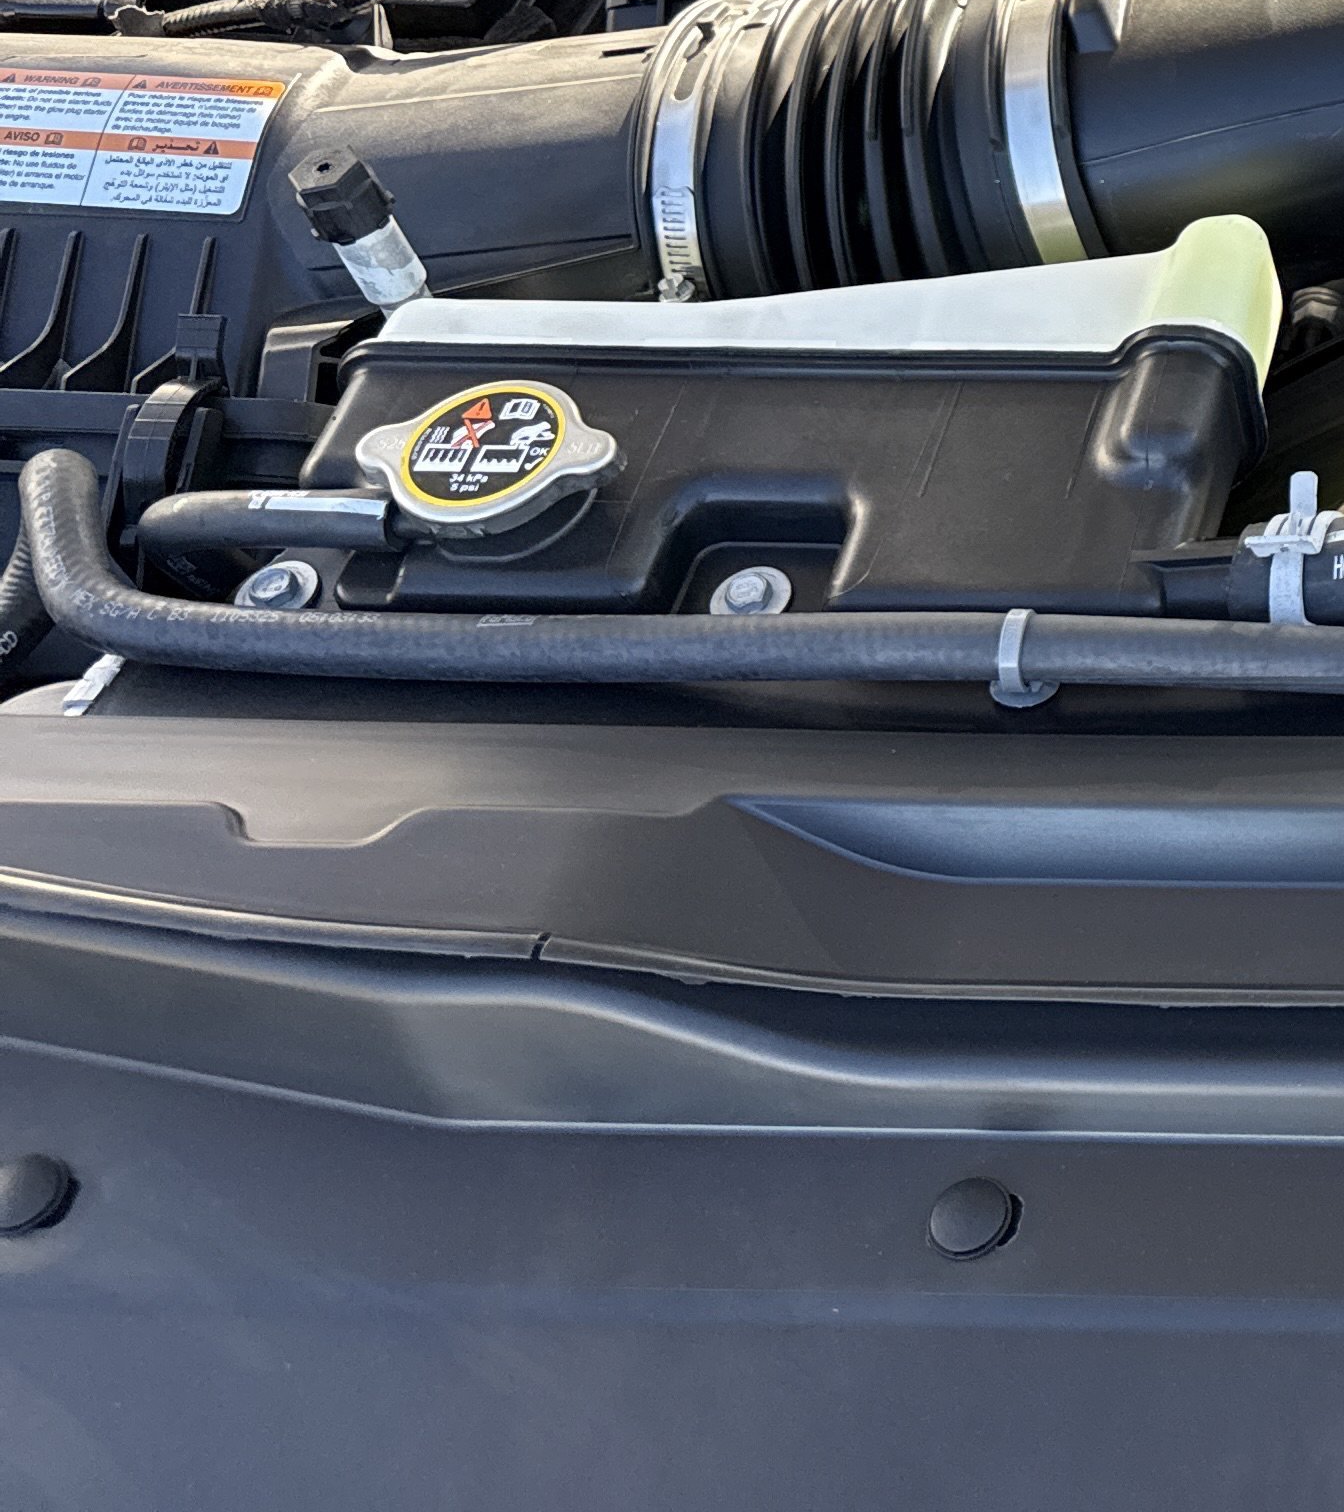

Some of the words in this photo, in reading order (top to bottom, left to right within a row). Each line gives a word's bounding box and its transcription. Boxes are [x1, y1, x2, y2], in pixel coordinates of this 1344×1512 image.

[24, 74, 80, 85] WARNING
[155, 80, 254, 94] AVERTISSEMENT
[4, 131, 41, 142] AVISO
[529, 446, 549, 457] OK
[450, 473, 466, 483] 34
[466, 472, 488, 483] kPa
[459, 482, 479, 494] psi
